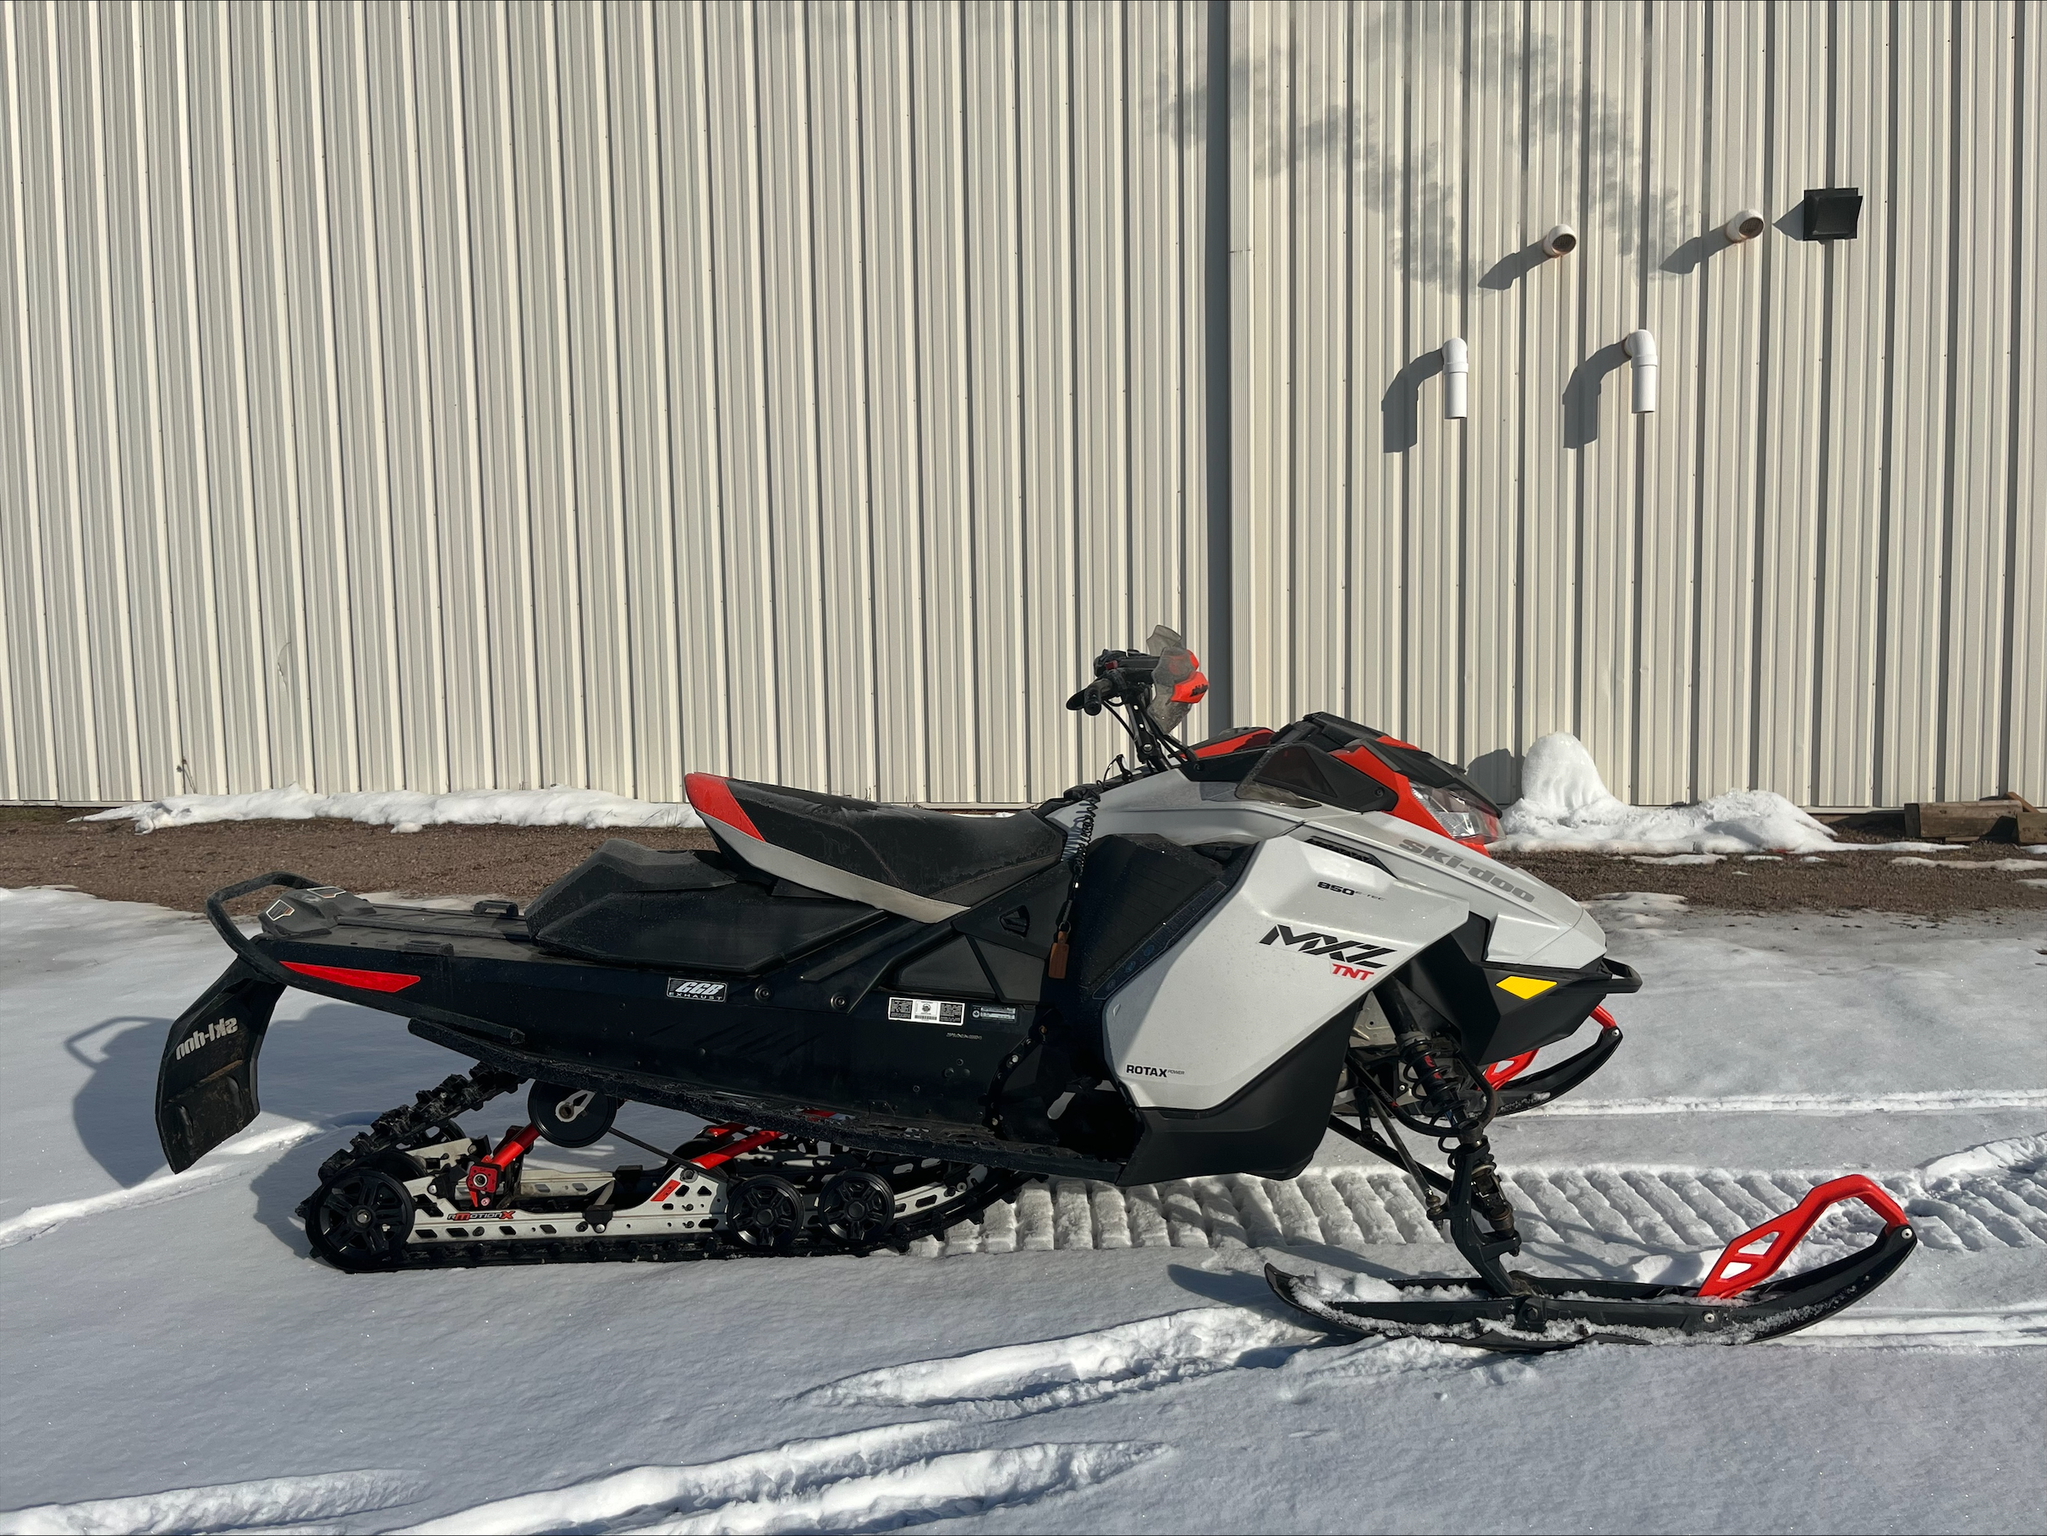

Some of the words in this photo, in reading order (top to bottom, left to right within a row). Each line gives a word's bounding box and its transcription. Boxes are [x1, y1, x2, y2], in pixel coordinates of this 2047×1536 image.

[1399, 838, 1535, 903] ski-doo
[1317, 881, 1355, 896] 850
[1258, 924, 1398, 969] MXZ
[1332, 963, 1375, 981] TNT
[668, 991, 723, 1001] EXHAUST
[1126, 1064, 1167, 1078] ROTAX
